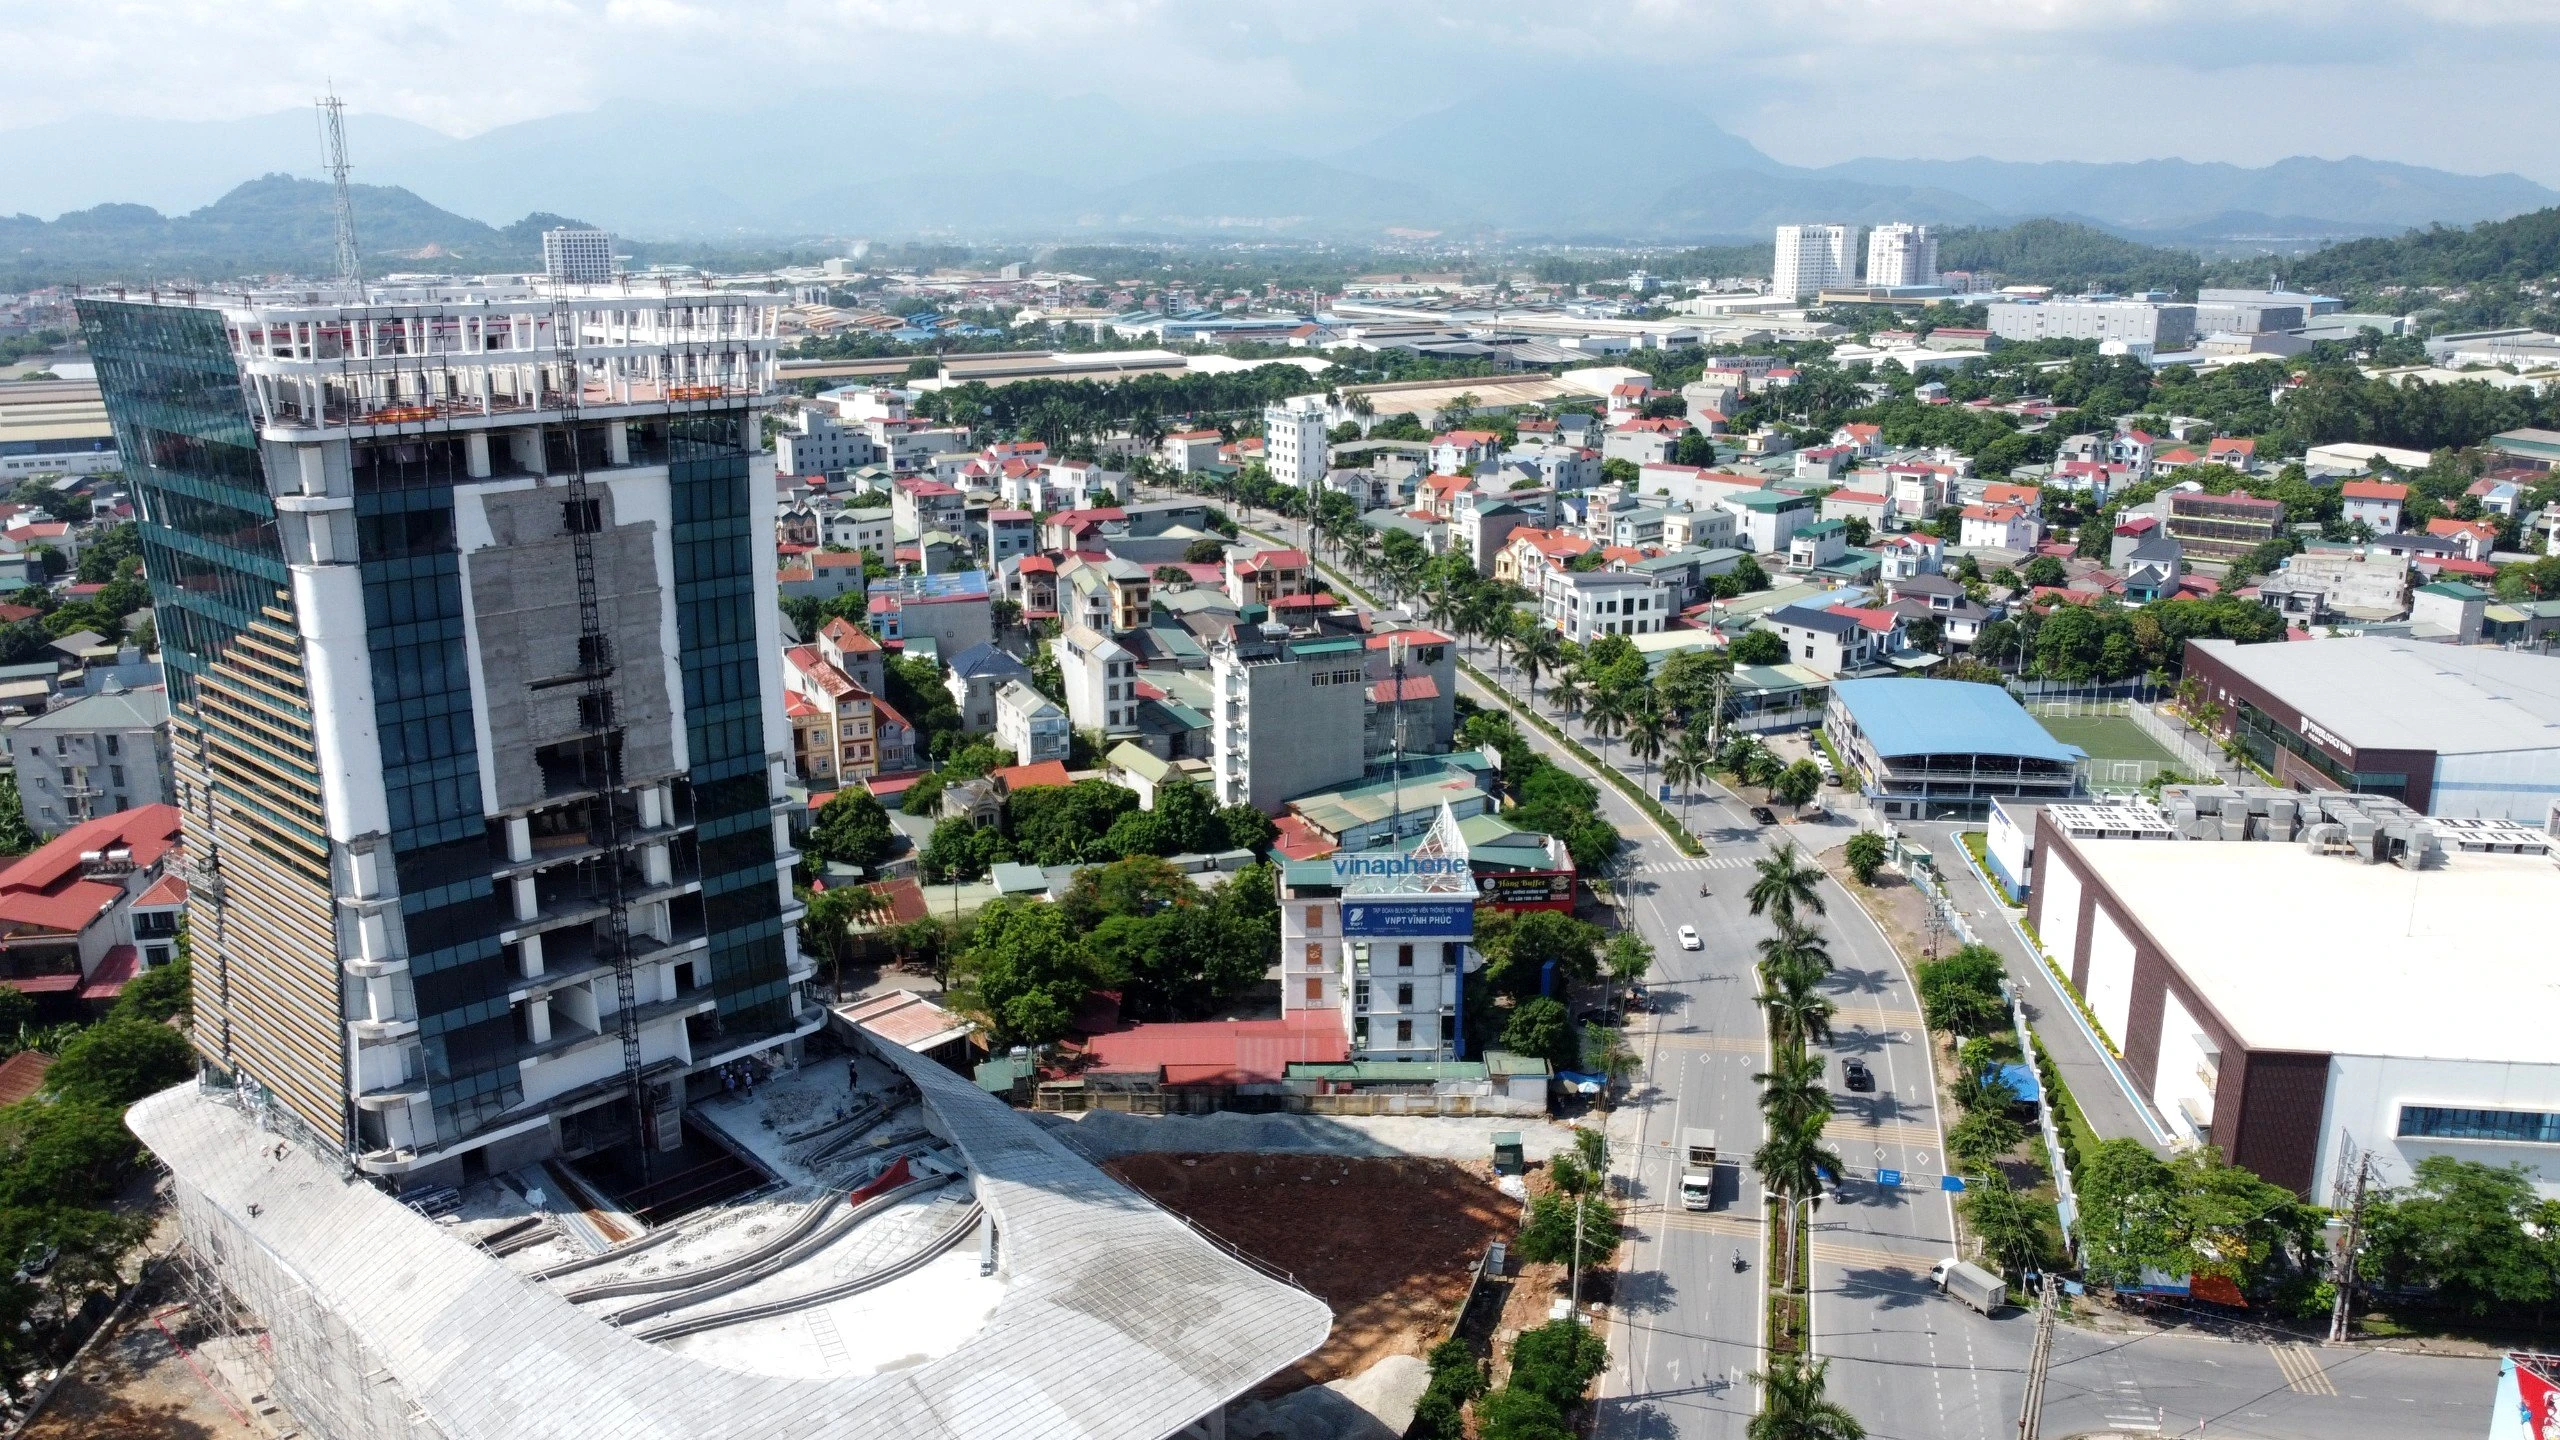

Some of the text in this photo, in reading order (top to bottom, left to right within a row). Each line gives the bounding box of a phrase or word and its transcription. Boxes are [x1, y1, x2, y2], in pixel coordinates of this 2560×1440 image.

[1332, 853, 1467, 878] vinaphone
[1385, 914, 1452, 925] VNPT VĨNH PHÚC
